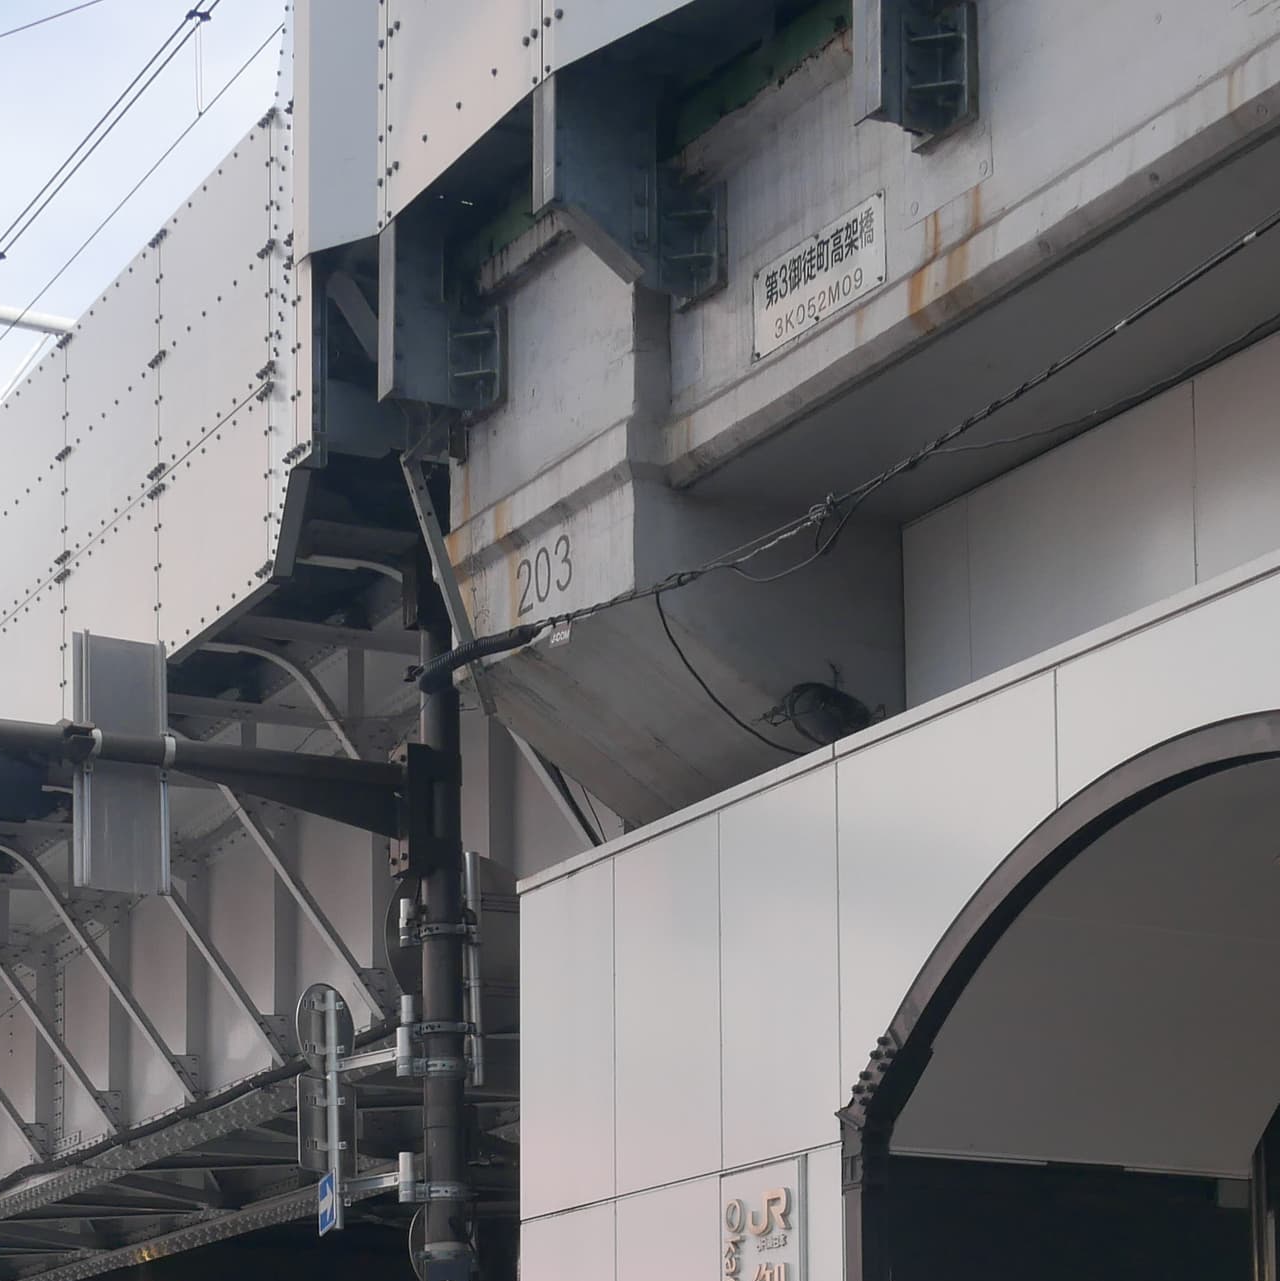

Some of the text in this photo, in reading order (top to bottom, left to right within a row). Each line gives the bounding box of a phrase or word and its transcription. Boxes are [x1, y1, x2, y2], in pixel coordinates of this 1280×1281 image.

[765, 207, 874, 310] 第3御徒町高架橋
[775, 268, 864, 339] 3K052M09
[516, 535, 572, 617] 203
[749, 1187, 792, 1236] JR
